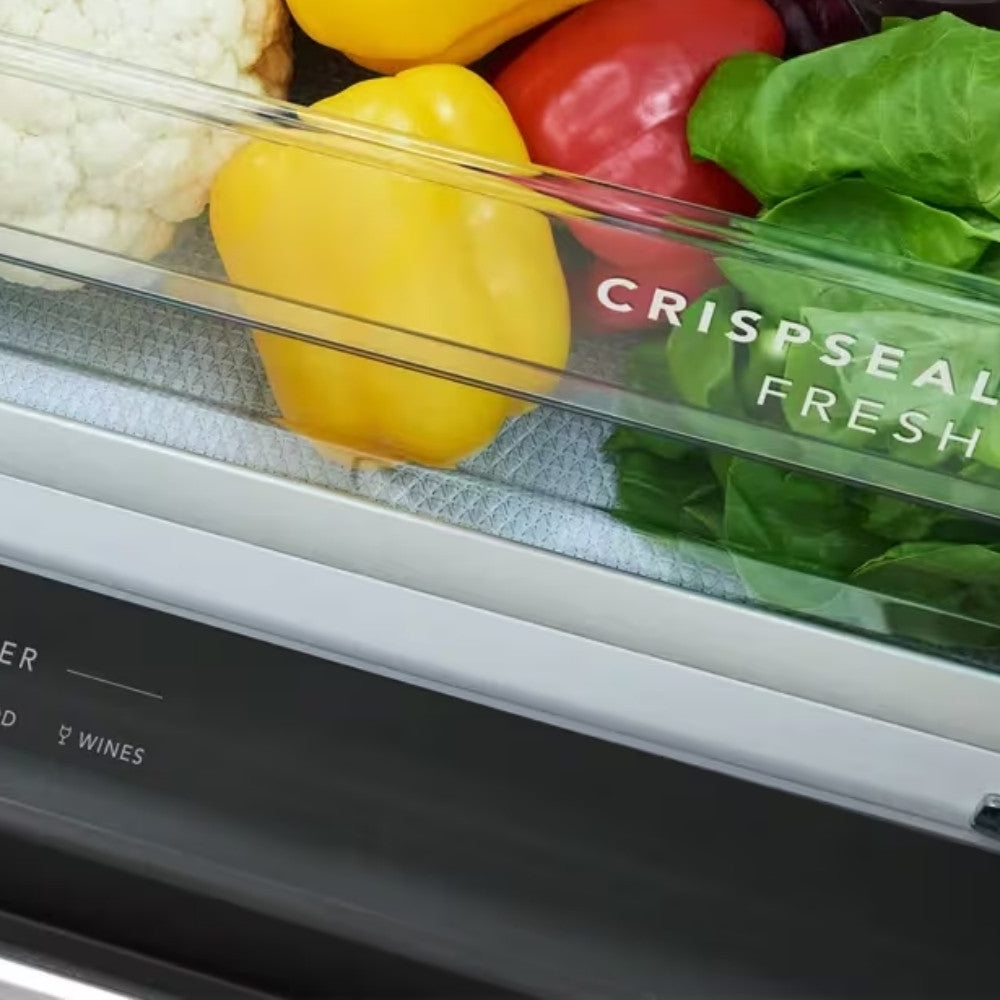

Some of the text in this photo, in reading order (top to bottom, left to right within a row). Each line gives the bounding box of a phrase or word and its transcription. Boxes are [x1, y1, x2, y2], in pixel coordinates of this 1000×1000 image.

[597, 277, 1000, 408] CRISPSEAL
[757, 375, 983, 459] FRESH
[78, 731, 146, 766] WINES
